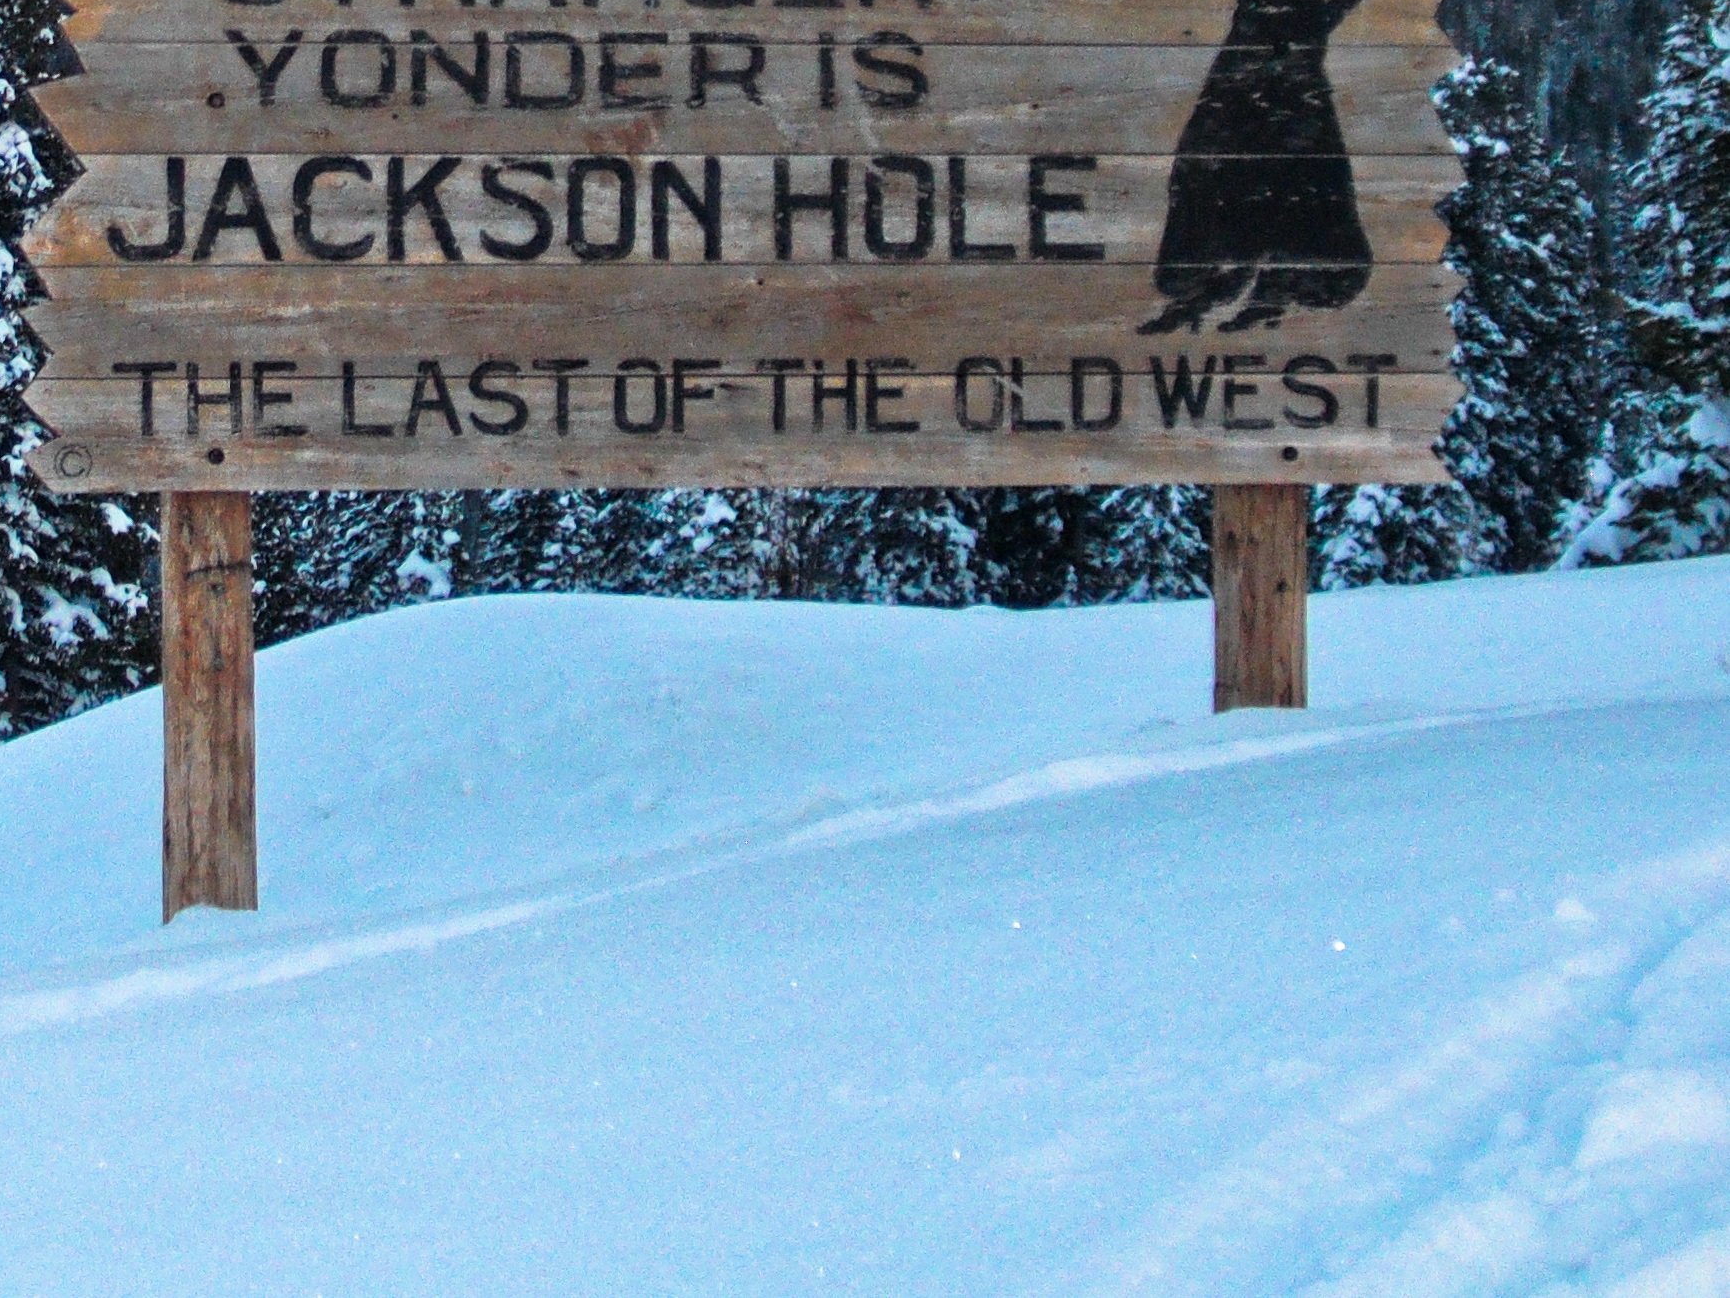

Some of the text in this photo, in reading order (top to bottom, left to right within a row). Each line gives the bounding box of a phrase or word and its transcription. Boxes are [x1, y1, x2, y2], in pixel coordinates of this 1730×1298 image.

[224, 29, 929, 112] YONDER IS
[106, 154, 1107, 262] JACKSON HOLE
[111, 353, 1399, 437] THE LAST OF THE OLD WEST
